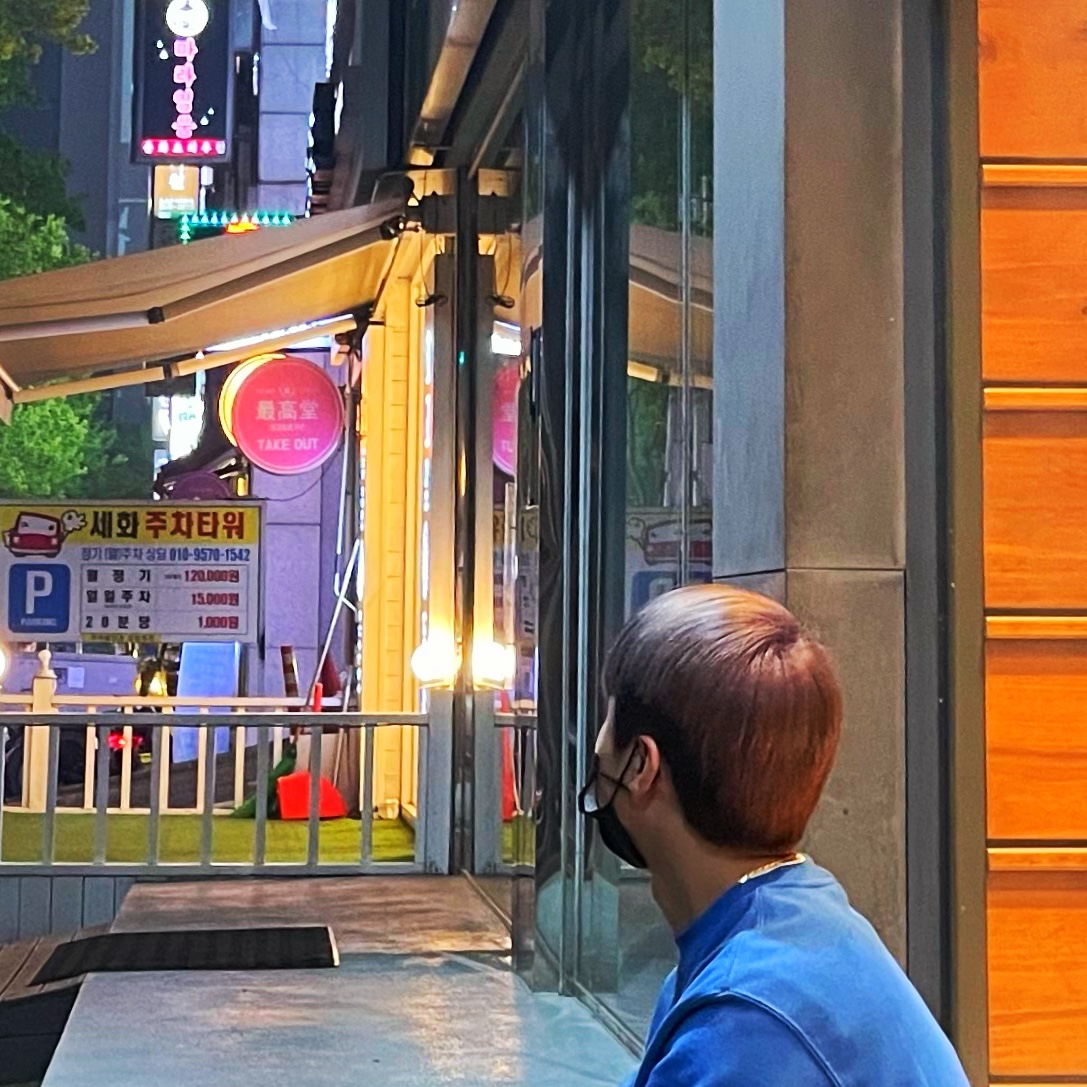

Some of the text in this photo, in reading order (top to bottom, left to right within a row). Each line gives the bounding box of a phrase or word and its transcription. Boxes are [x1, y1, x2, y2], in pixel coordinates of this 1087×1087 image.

[257, 437, 319, 451] TAKE OUT
[90, 510, 245, 539] 세화 주차타워
[25, 570, 53, 615] P
